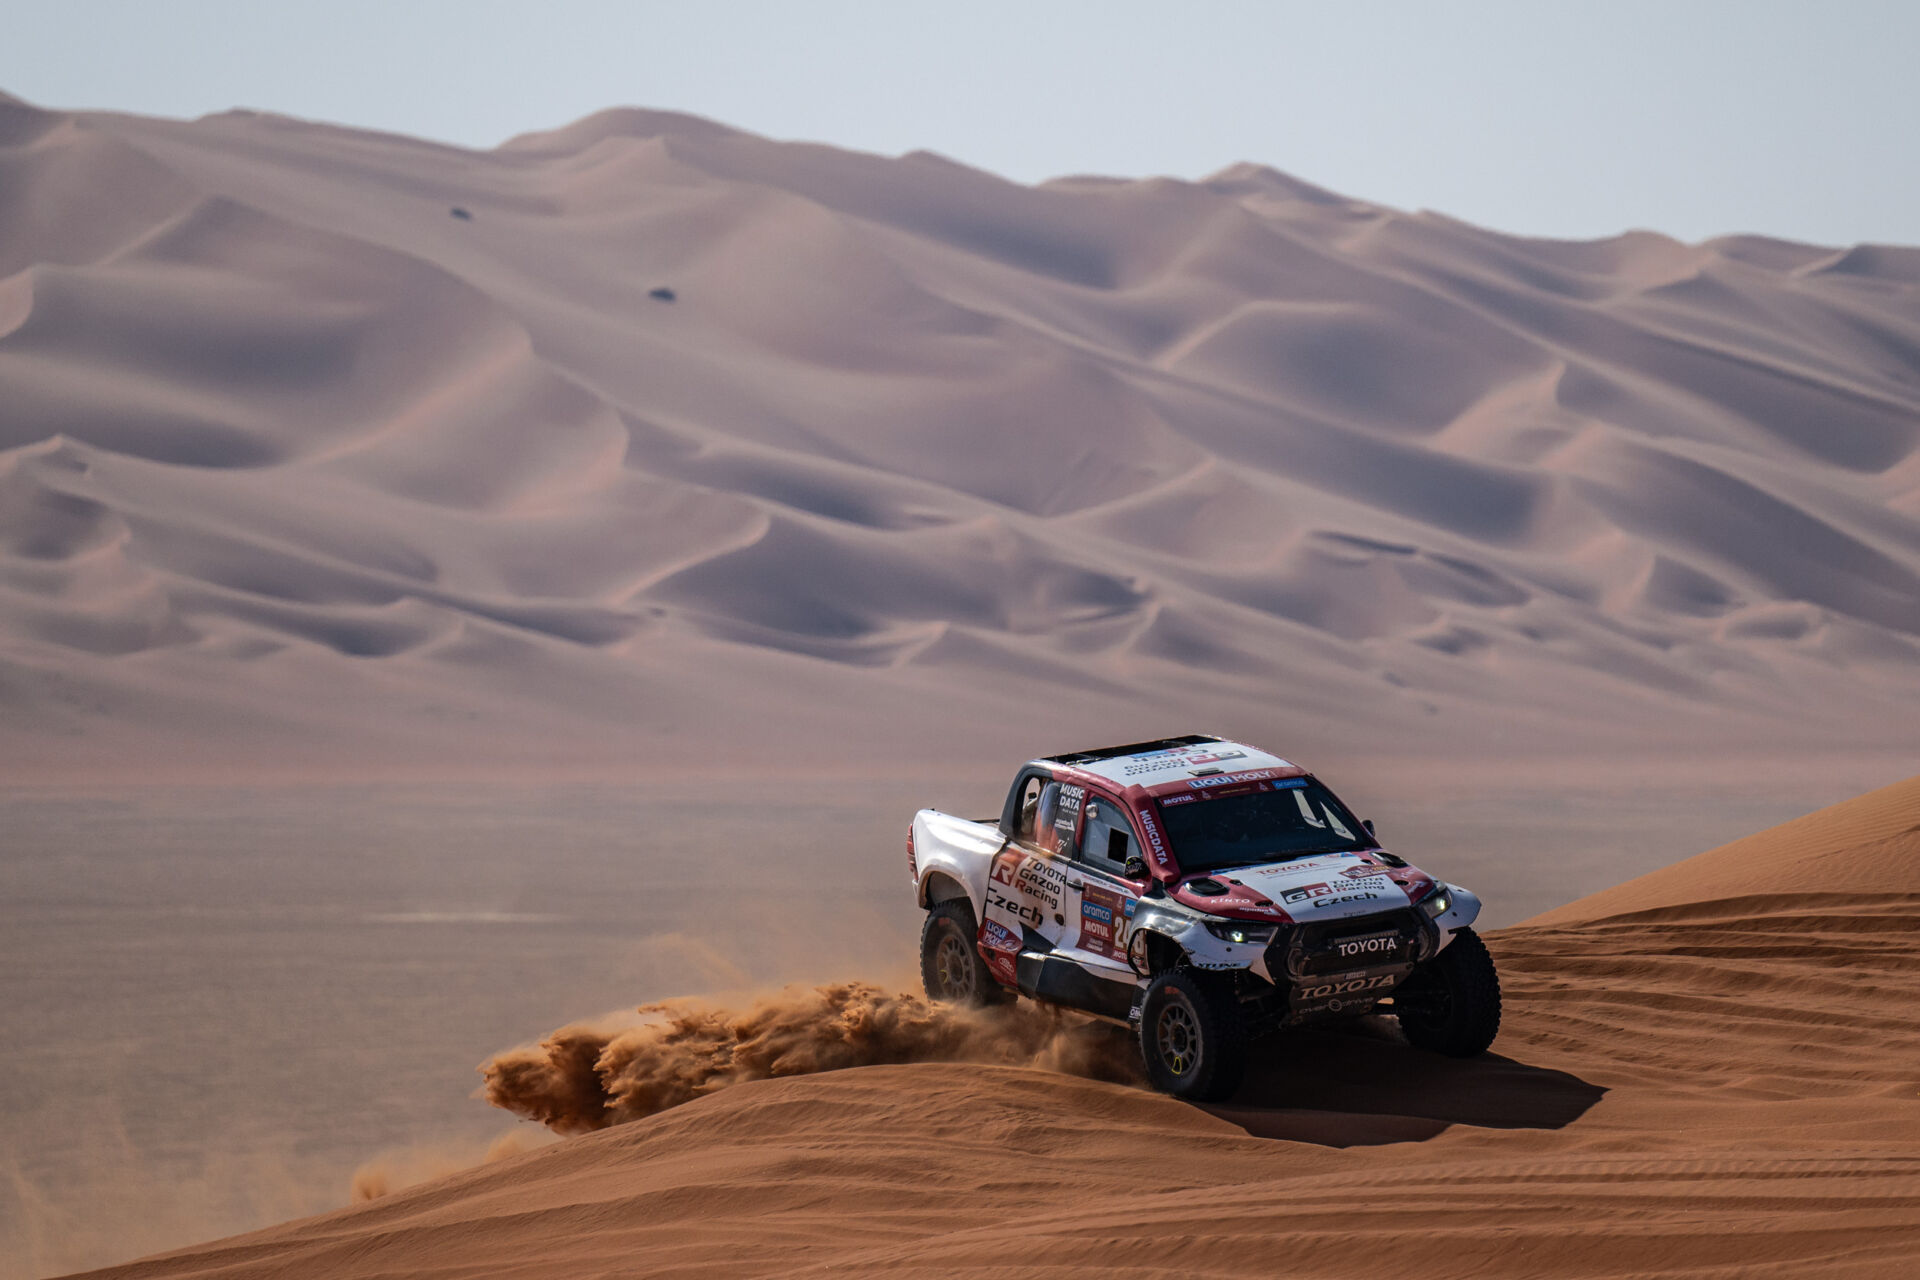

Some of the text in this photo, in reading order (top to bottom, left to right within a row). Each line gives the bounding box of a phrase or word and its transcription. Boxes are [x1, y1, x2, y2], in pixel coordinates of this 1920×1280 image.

[1191, 769, 1274, 789] LIQUI MOLY
[1060, 783, 1086, 800] MUSIC
[1163, 795, 1194, 805] MOTUL
[1060, 796, 1081, 812] DATA
[1139, 809, 1169, 866] MUSICDATA
[1026, 856, 1067, 885] TOYOTA
[1255, 862, 1320, 876] TOYOTA
[1019, 867, 1061, 895] GAZOO
[1329, 876, 1385, 884] TOYOTA
[1336, 885, 1385, 893] Racing
[1015, 879, 1058, 910] Racing
[1283, 884, 1332, 903] GR
[1313, 892, 1378, 908] Czech
[1083, 904, 1110, 921] aramco
[987, 920, 1009, 940] LIQUI
[1084, 920, 1109, 938] MOTUL
[1113, 950, 1128, 960] MOTU
[1338, 937, 1397, 957] TOYOTA
[1298, 974, 1395, 1000] TOYOTA
